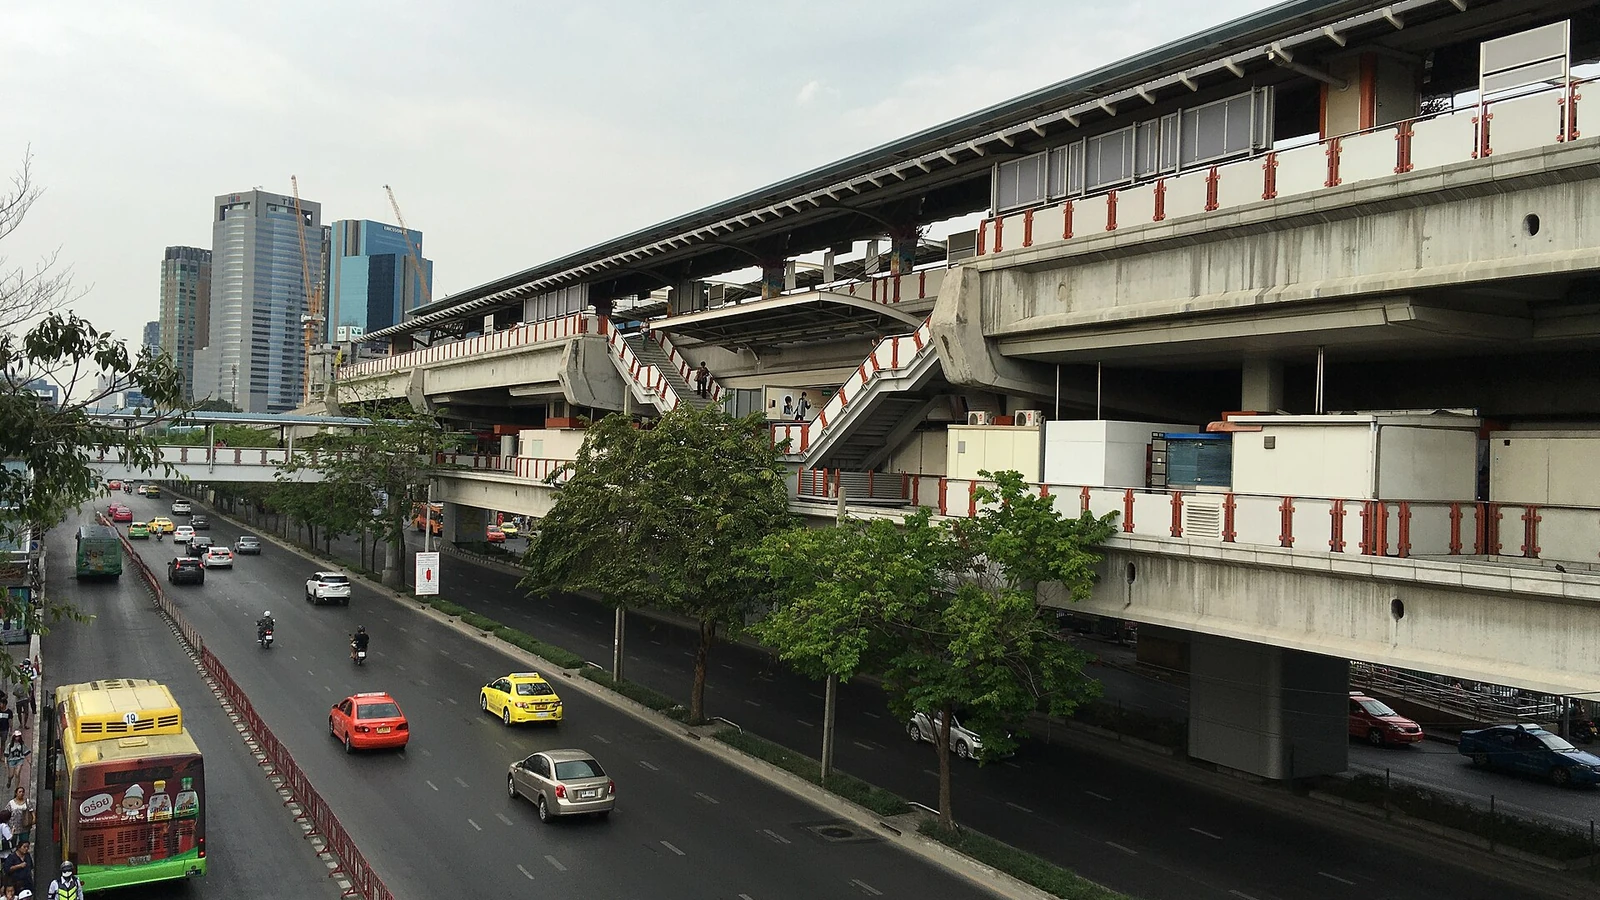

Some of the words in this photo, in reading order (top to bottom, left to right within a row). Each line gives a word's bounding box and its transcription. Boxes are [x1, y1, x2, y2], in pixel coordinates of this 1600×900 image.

[383, 225, 403, 235] ERICSSON
[126, 713, 136, 725] 19
[83, 797, 110, 814] อร่อย
